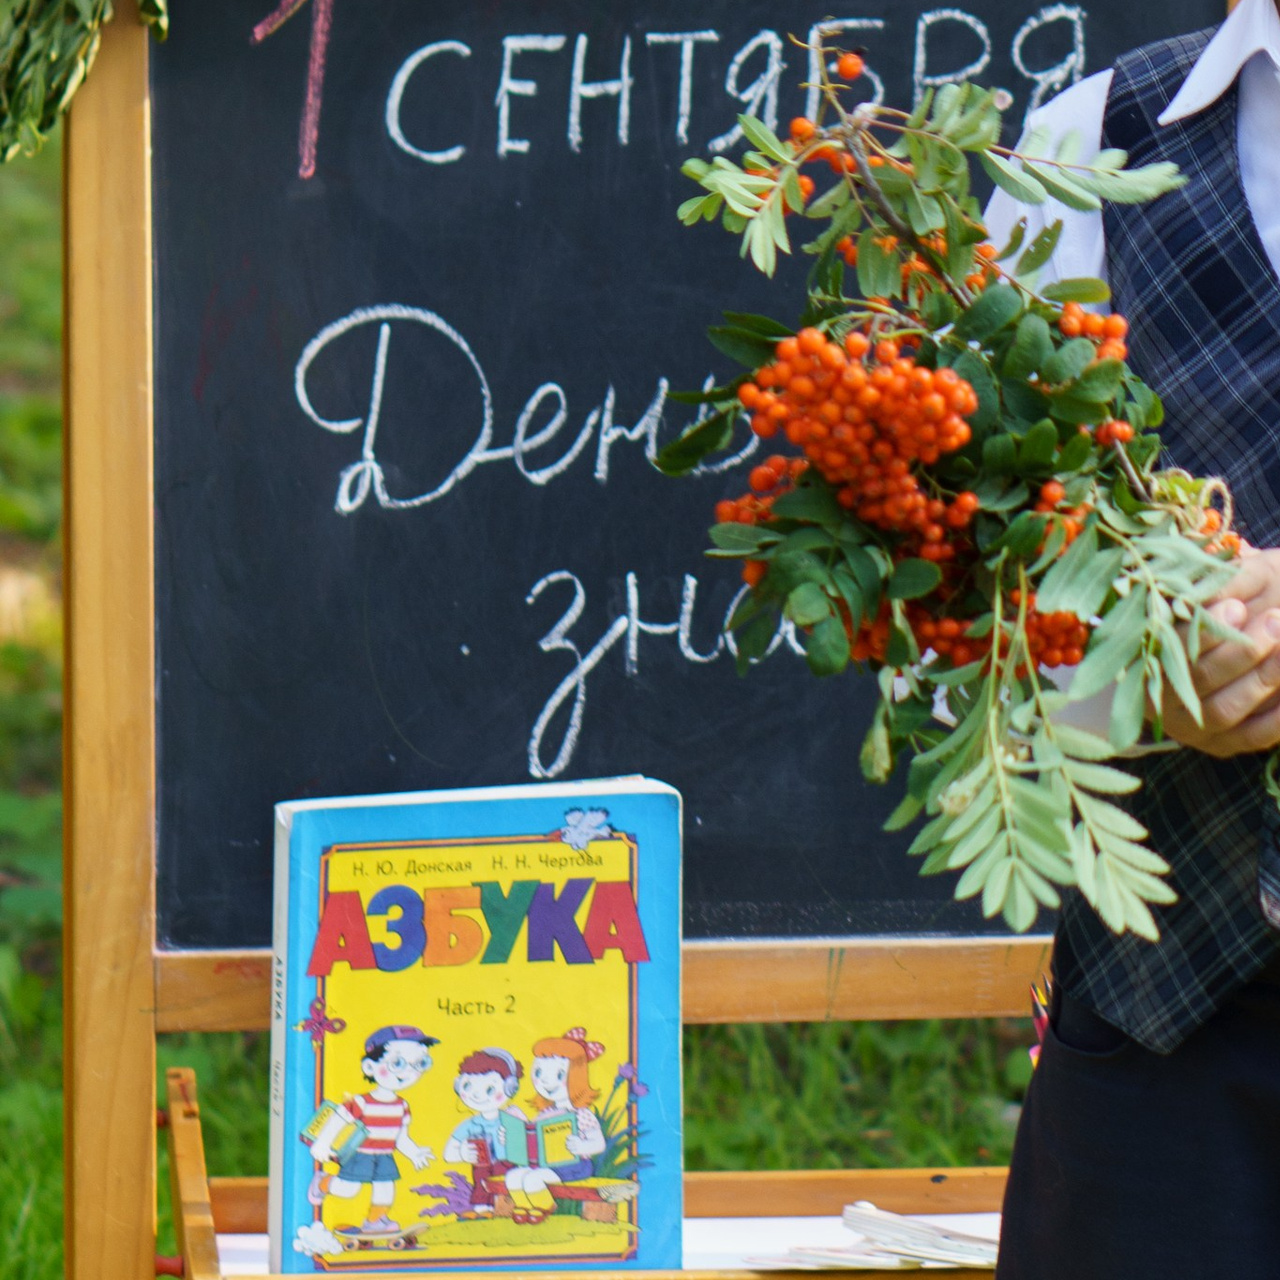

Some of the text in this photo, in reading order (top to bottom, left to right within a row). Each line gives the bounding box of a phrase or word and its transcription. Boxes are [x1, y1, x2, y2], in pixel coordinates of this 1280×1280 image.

[353, 853, 604, 877] Н. Ю. Донская Н. Н. Чертова
[307, 878, 651, 976] АЗБУКА
[437, 995, 516, 1017] Часть 2
